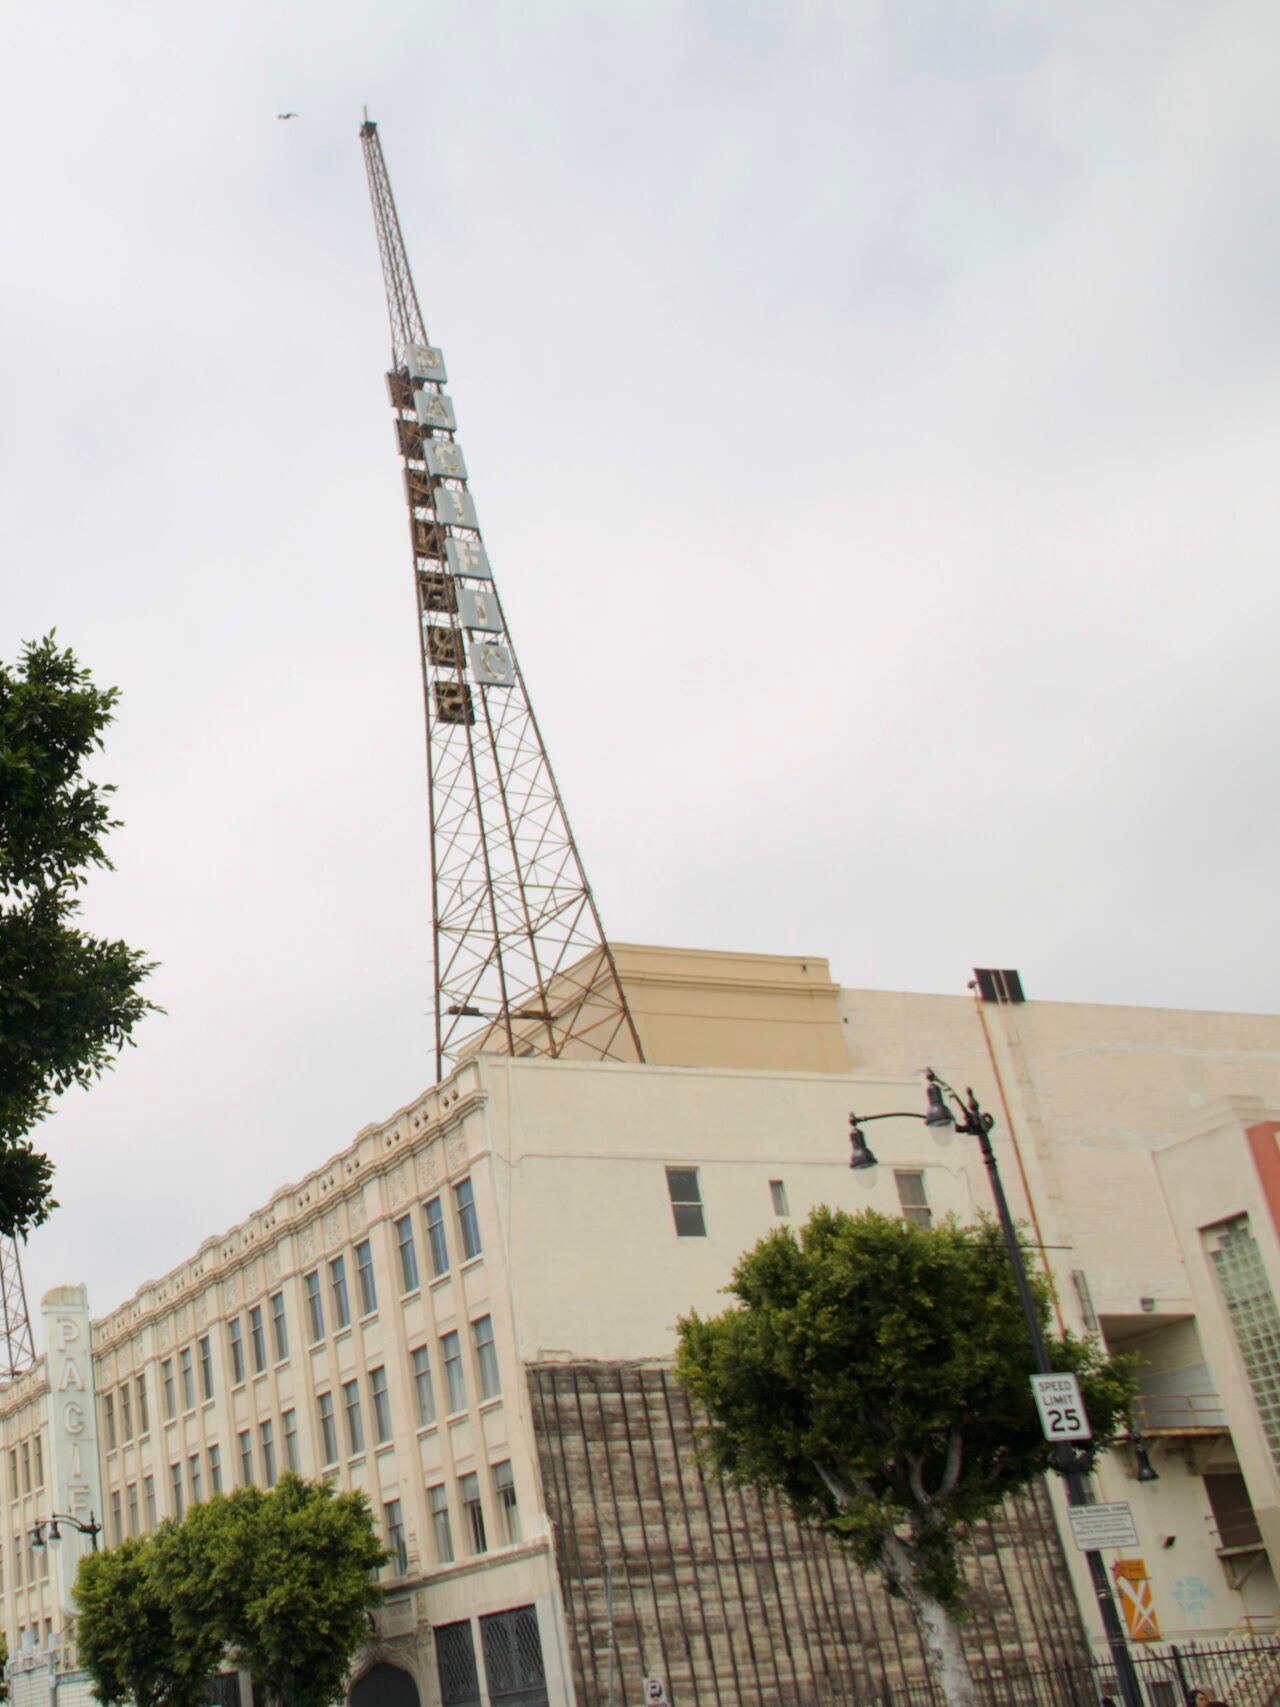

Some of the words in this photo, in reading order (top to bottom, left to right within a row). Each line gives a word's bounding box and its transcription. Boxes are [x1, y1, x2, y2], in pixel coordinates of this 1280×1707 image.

[414, 345, 508, 683] PACIFIC
[1038, 1381, 1072, 1391] SPEED
[1042, 1395, 1072, 1406] LIMIT
[1047, 1409, 1081, 1431] 25
